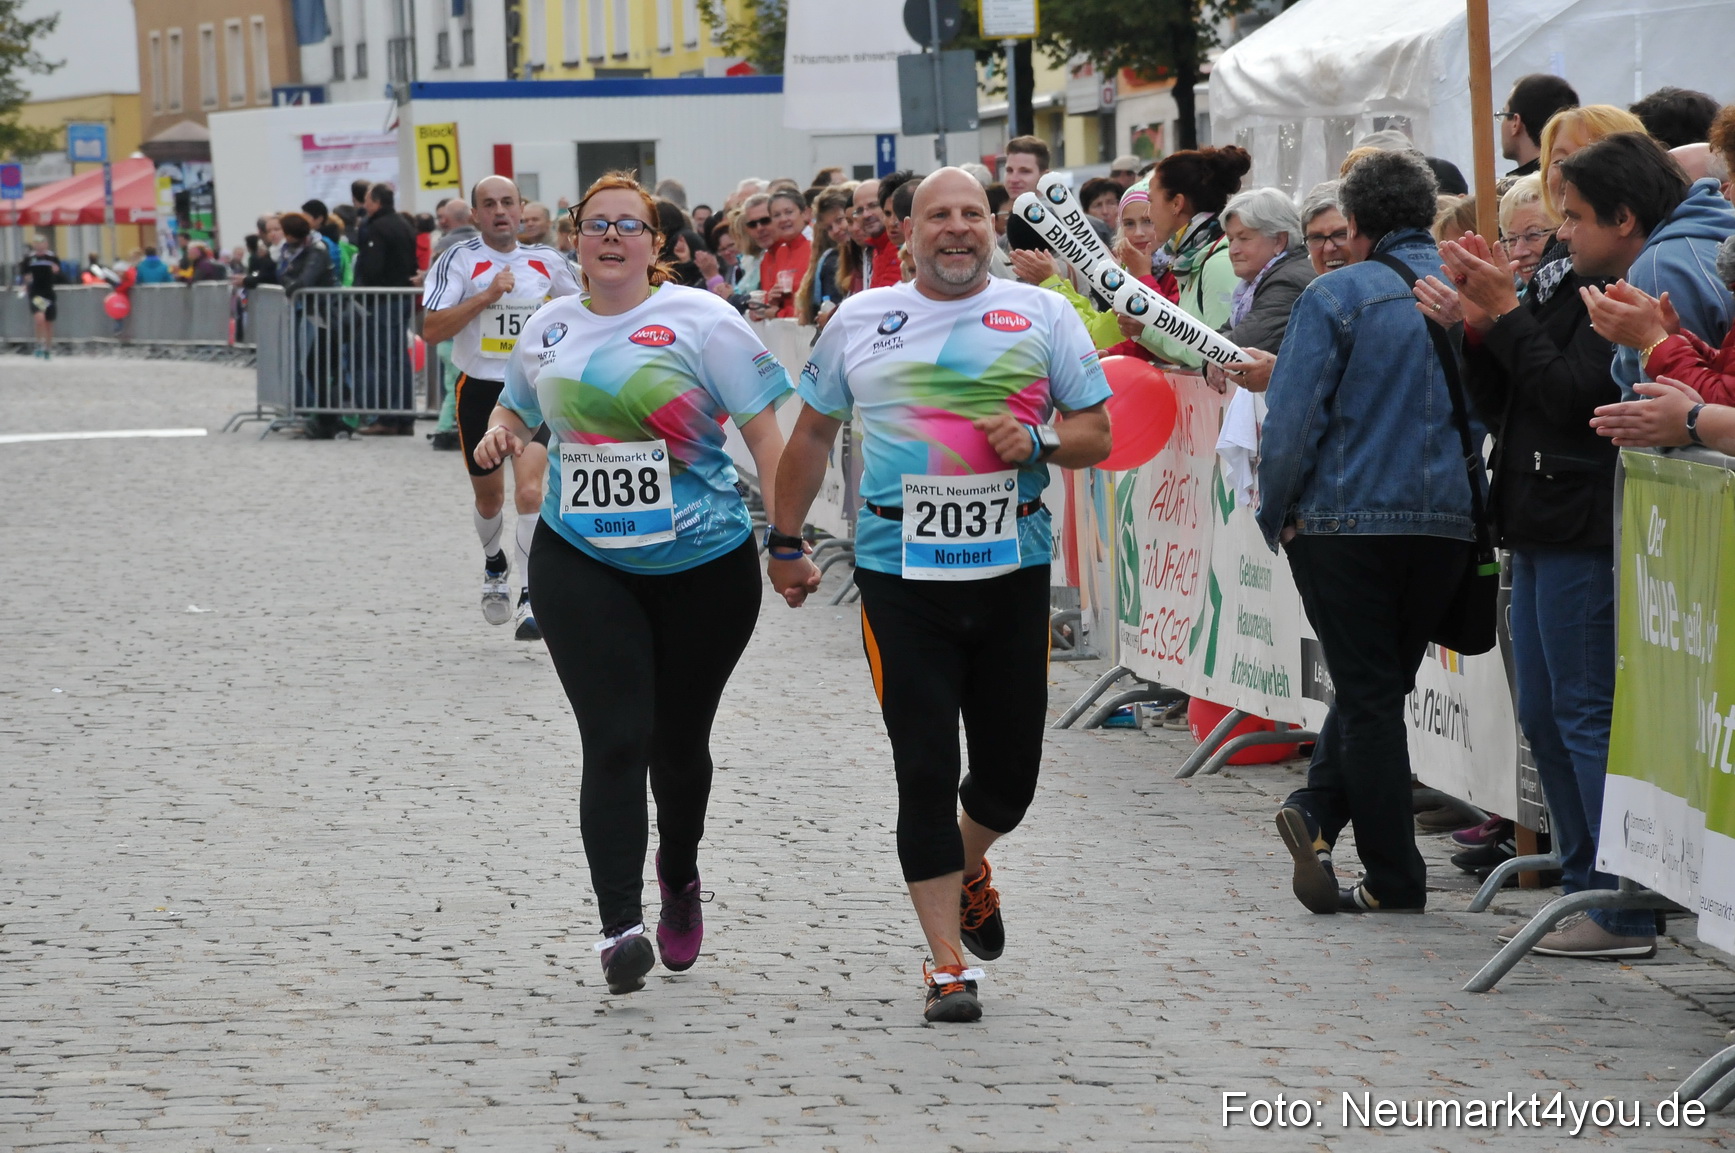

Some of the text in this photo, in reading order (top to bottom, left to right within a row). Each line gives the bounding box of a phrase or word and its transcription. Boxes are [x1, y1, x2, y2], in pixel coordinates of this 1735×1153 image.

[420, 127, 455, 139] Block
[428, 144, 450, 175] D
[1045, 224, 1087, 264] BMW
[1063, 210, 1100, 252] BMW
[989, 312, 1027, 327] Hervis
[1152, 309, 1201, 344] BMW
[634, 330, 671, 342] Hervis
[562, 452, 647, 463] PARTL Neumarkt
[572, 467, 660, 507] 2038
[905, 483, 1001, 496] PARTL Neumarkt
[594, 518, 636, 535] Sonja
[916, 497, 1009, 538] 2037
[1647, 504, 1667, 558] Der
[935, 548, 992, 564] Norbert
[1636, 553, 1680, 651] Neue
